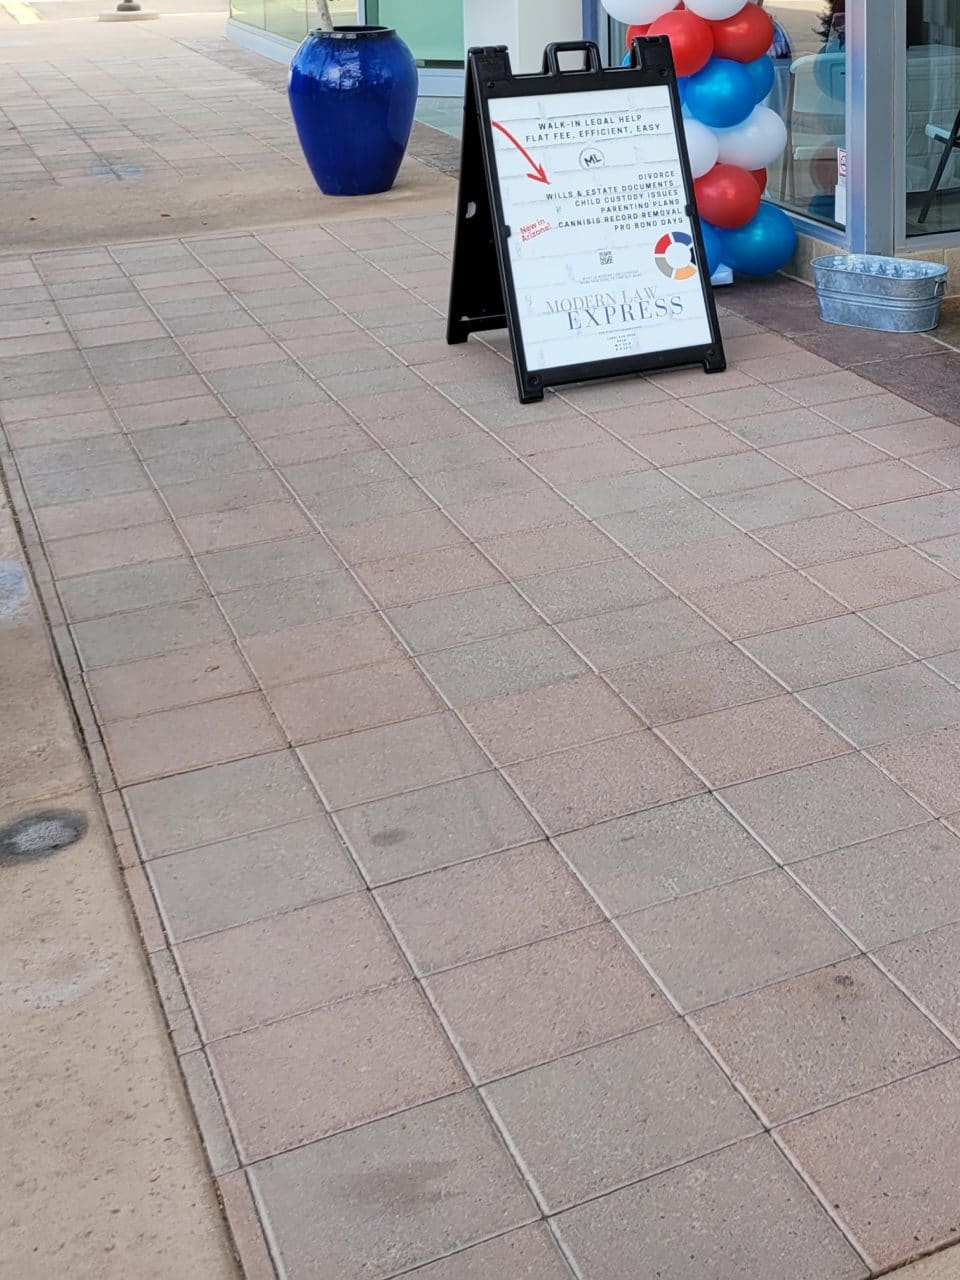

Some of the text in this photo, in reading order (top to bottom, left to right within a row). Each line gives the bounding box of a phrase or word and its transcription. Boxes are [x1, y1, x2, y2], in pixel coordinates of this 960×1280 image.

[538, 114, 643, 131] WALK-IN LEGAL HELP
[525, 123, 661, 143] FLAT FEE, EFFICIENT, EASY
[583, 154, 602, 167] ML
[638, 170, 676, 181] DIVORCE
[546, 180, 674, 200] WILLS & ESTATE DOCUMENTS
[574, 189, 679, 207] CHILD CUSTODY ISSUES
[600, 198, 681, 213] PARENTING PLANS
[604, 212, 639, 223] RECORD
[641, 207, 682, 218] REMOVAL
[520, 218, 546, 234] New in
[614, 217, 684, 231] PRO BONO DAYS
[545, 286, 658, 314] MODERN LAW
[567, 295, 684, 330] EXPRESS
